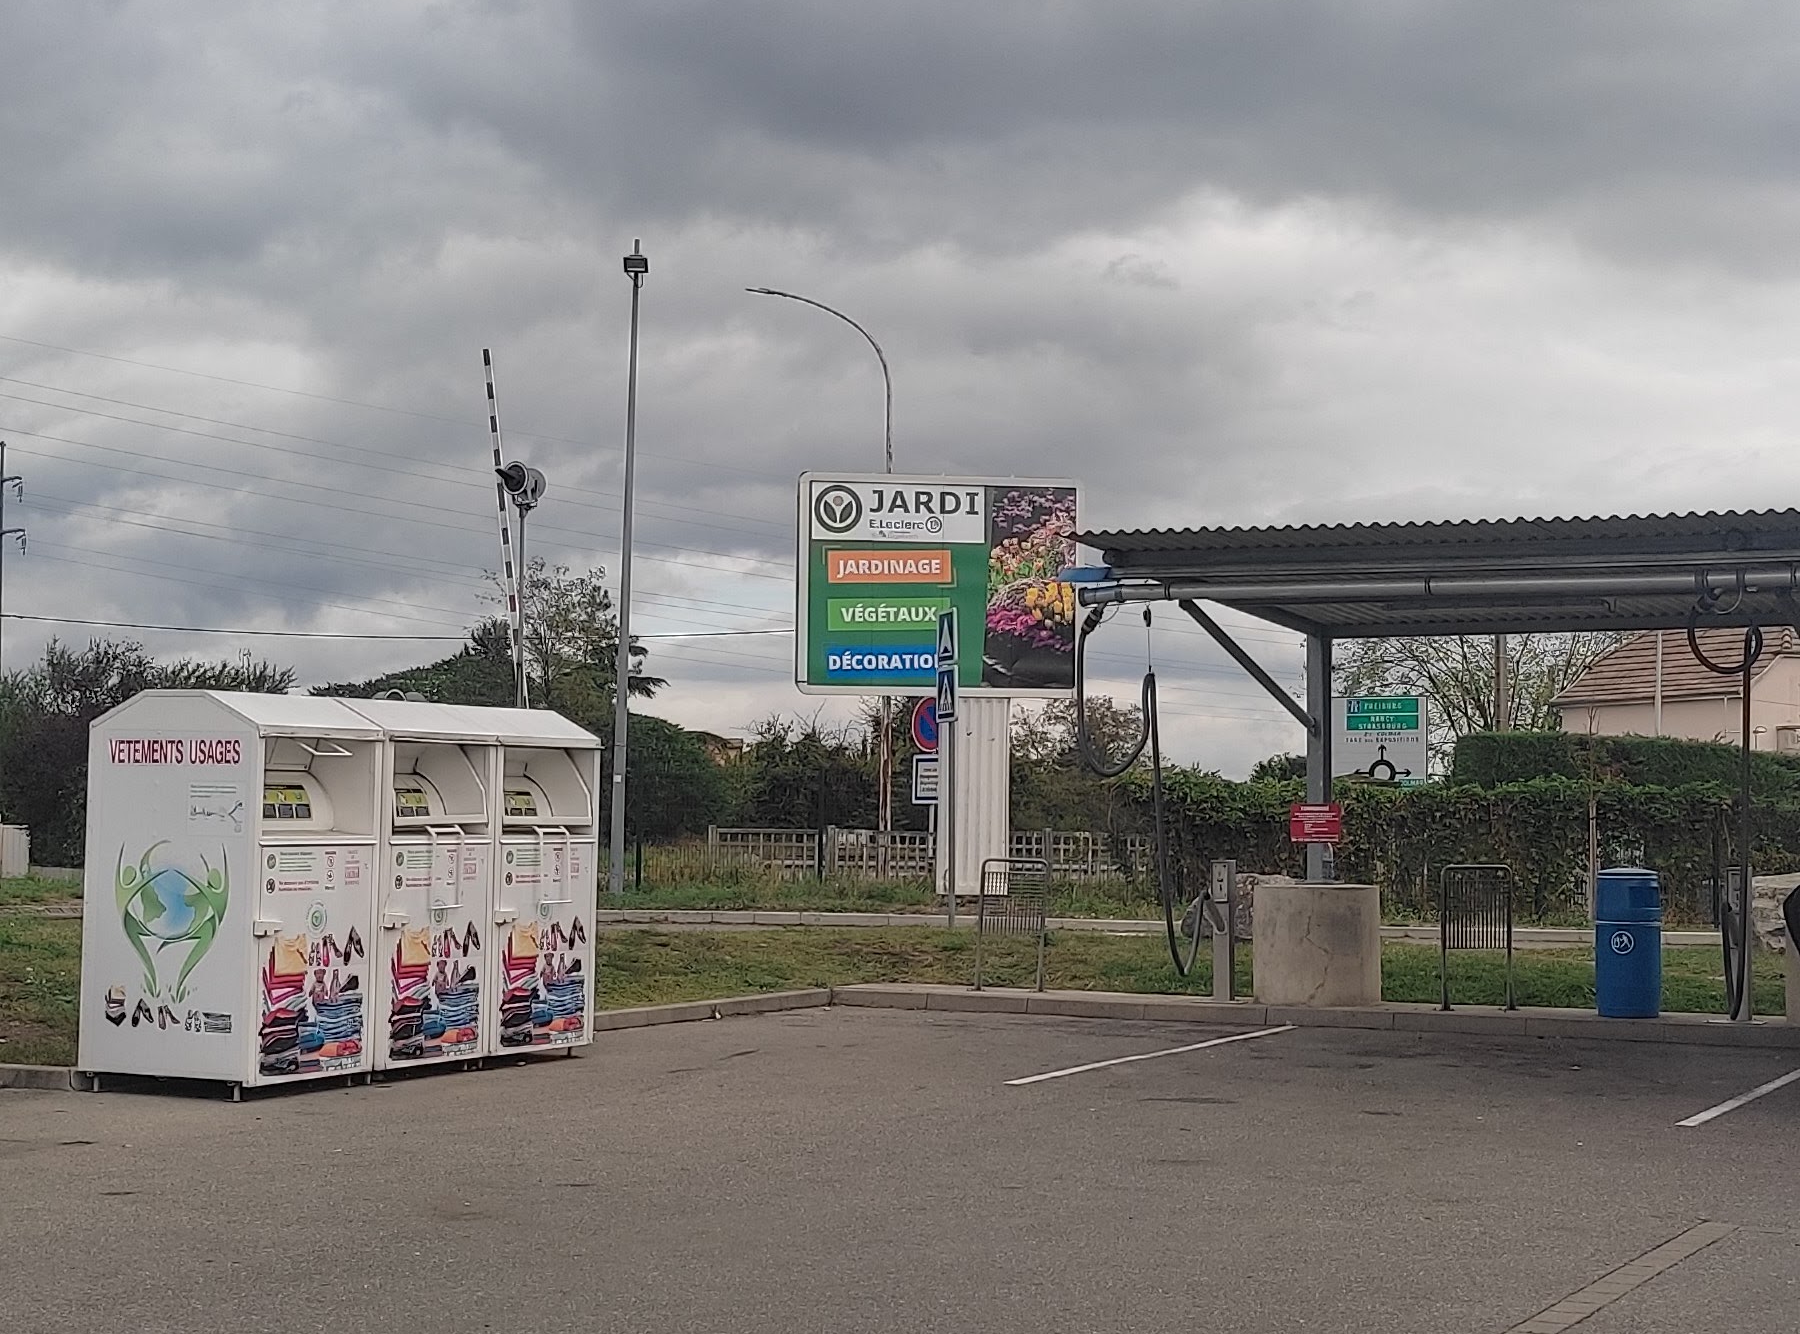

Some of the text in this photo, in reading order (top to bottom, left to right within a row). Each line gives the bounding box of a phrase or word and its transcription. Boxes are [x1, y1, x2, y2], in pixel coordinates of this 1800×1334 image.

[869, 489, 980, 516] JARDI
[837, 559, 941, 578] JARDINAGE
[841, 604, 937, 622] VÉGÉTAUX
[828, 651, 939, 671] DÉCORATIO
[109, 739, 241, 765] VETEMENTS USAGES
